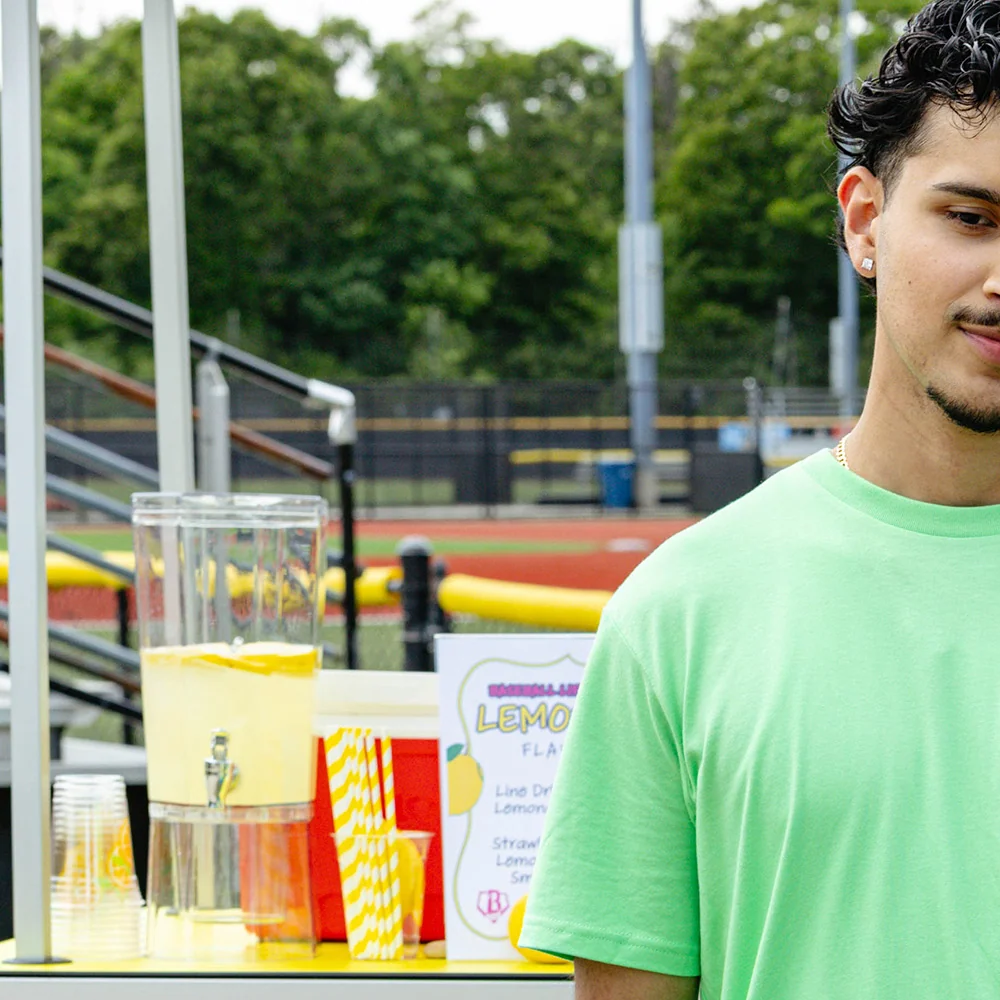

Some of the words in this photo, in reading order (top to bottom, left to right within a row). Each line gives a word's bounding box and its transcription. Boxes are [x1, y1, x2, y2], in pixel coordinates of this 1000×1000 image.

[476, 702, 572, 734] LEMO
[522, 742, 564, 758] FLA
[495, 784, 528, 798] Line
[494, 801, 548, 815] Lemon
[492, 837, 541, 850] Straw
[496, 854, 537, 867] Lemo
